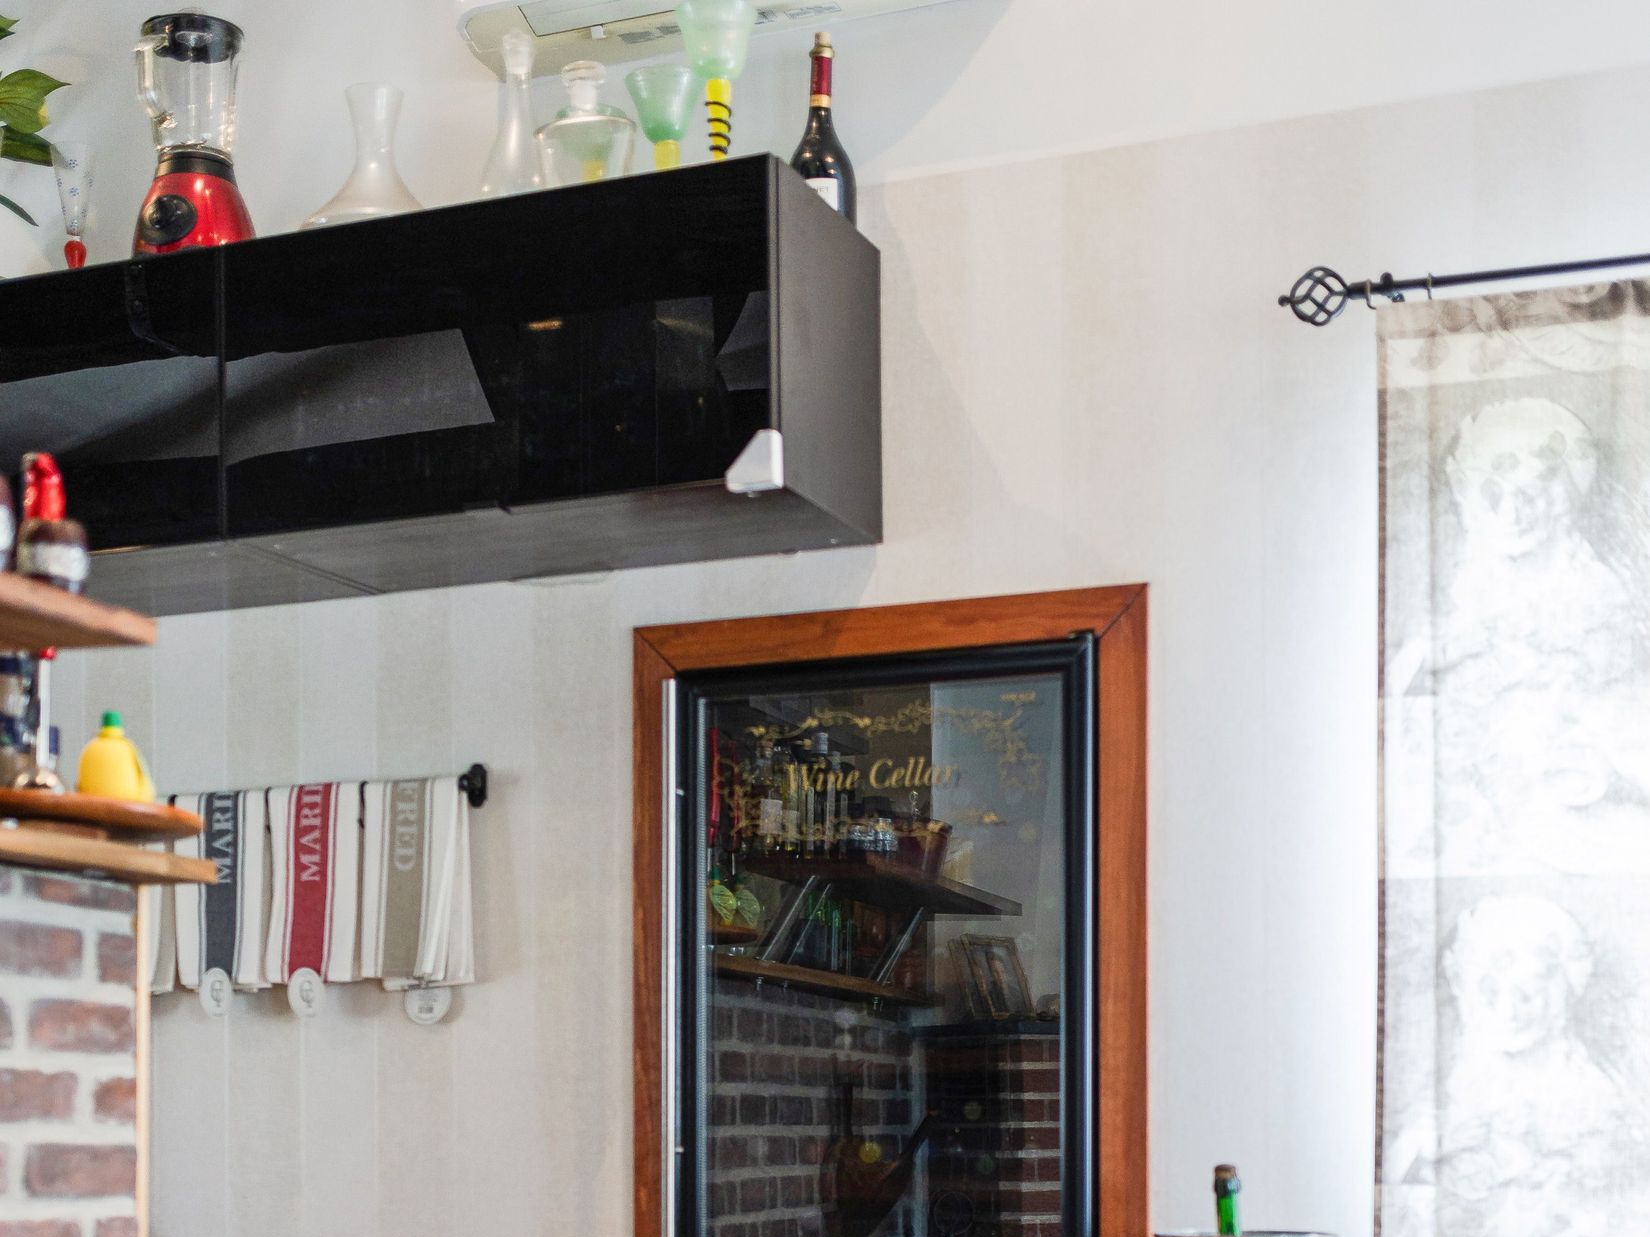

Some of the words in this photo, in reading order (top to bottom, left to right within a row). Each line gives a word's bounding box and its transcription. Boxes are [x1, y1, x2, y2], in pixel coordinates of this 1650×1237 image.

[785, 756, 862, 793] Wine
[869, 756, 959, 789] Cellar
[212, 791, 233, 884] MARI
